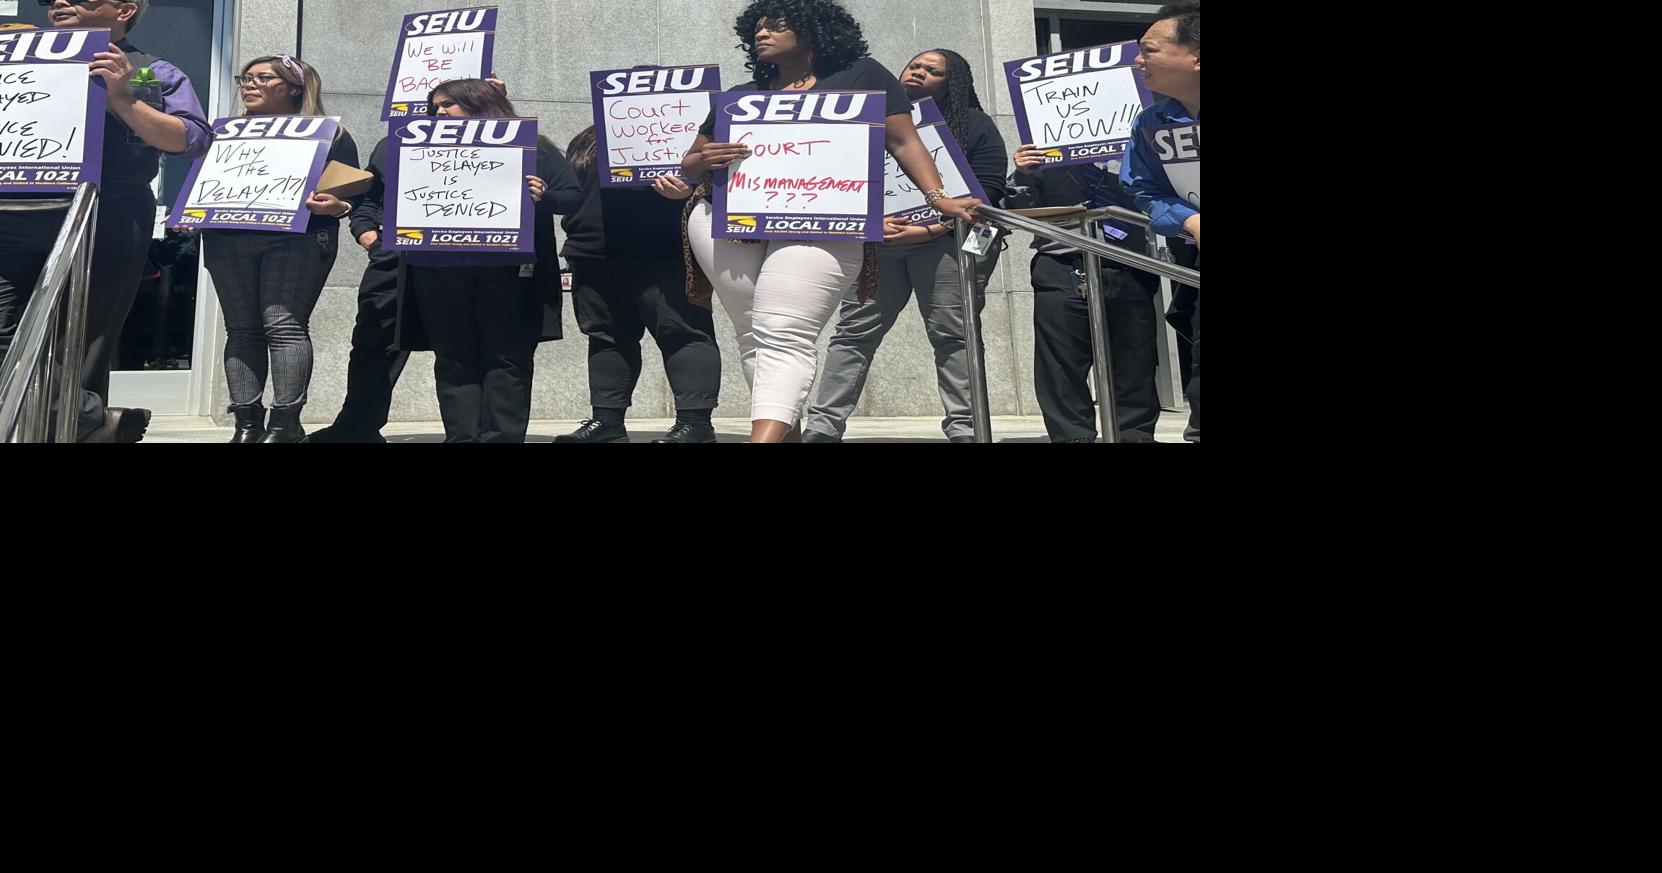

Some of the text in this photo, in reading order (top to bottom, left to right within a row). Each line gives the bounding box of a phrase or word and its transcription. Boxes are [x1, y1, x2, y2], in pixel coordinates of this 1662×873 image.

[407, 9, 486, 35] SEIU
[422, 59, 453, 71] BE
[1020, 44, 1122, 82] SEIU
[603, 68, 704, 95] SEIU
[1024, 81, 1099, 105] TRAIN
[609, 98, 691, 120] Court
[732, 94, 867, 121] SEIU
[1056, 100, 1090, 119] US
[216, 117, 322, 139] SEIU
[401, 119, 521, 145] SEIU
[1070, 145, 1117, 157] LOCAL
[1154, 125, 1200, 160] SE
[215, 141, 266, 164] WHY
[410, 148, 481, 160] JUSTICE
[35, 171, 80, 181] 1021
[224, 162, 270, 177] THE
[431, 160, 504, 175] DELAYED
[444, 176, 458, 186] IS
[404, 186, 474, 201] JUSTICE
[211, 213, 257, 221] LOCAL
[262, 215, 294, 223] 1021
[422, 201, 508, 218] DENIED
[765, 220, 866, 231] LOCAL 1021
[431, 234, 519, 243] LOCAL 1021
